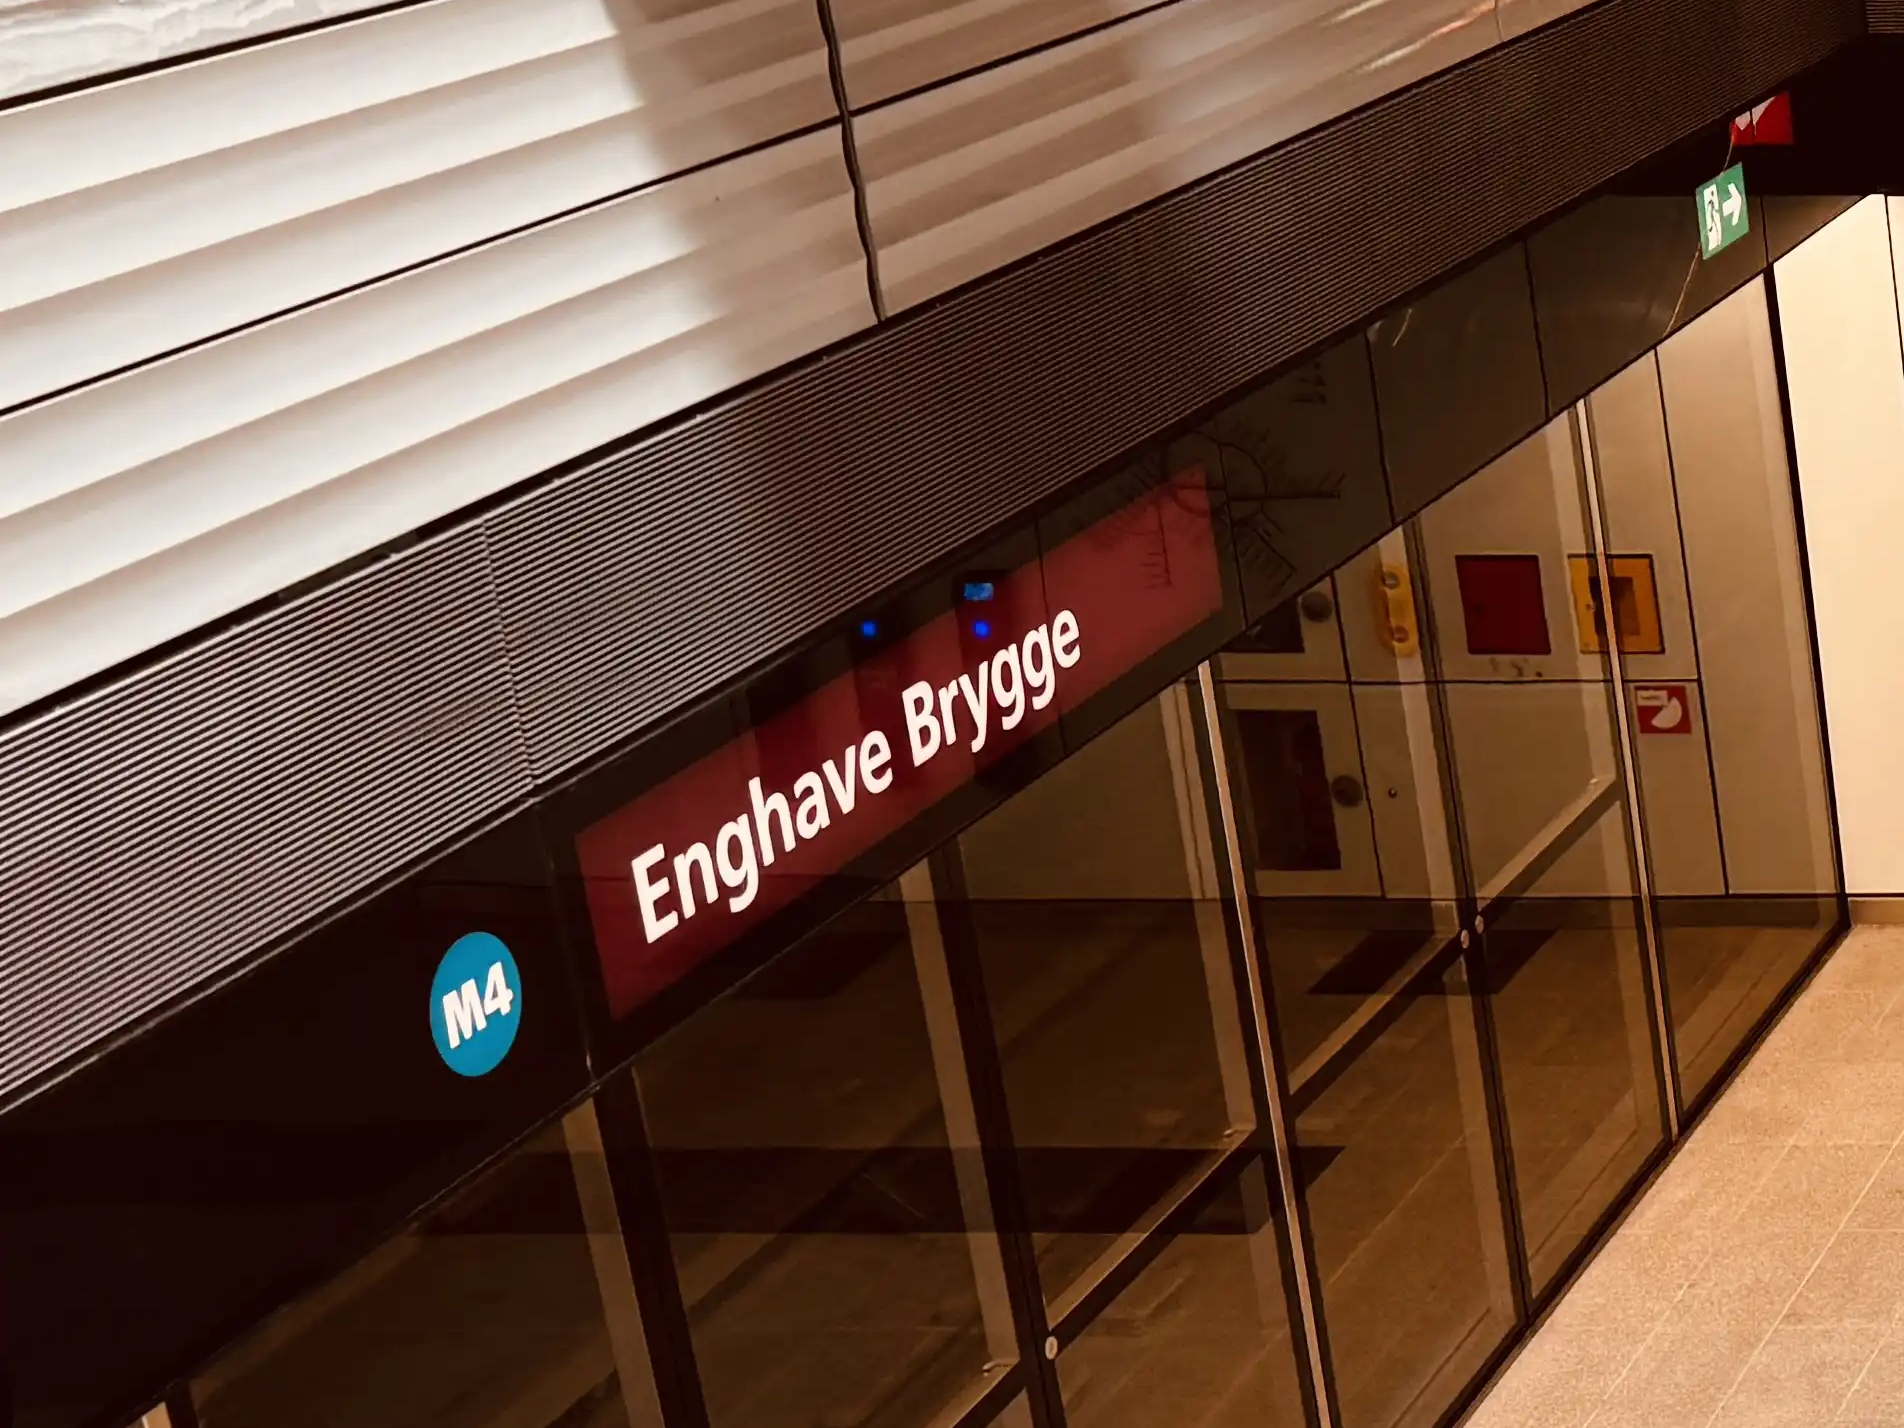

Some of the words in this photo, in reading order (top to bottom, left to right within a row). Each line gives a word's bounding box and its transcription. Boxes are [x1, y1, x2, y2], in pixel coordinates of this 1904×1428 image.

[631, 730, 894, 944] Enghave
[902, 609, 1082, 767] Brygge
[443, 960, 514, 1049] M4
